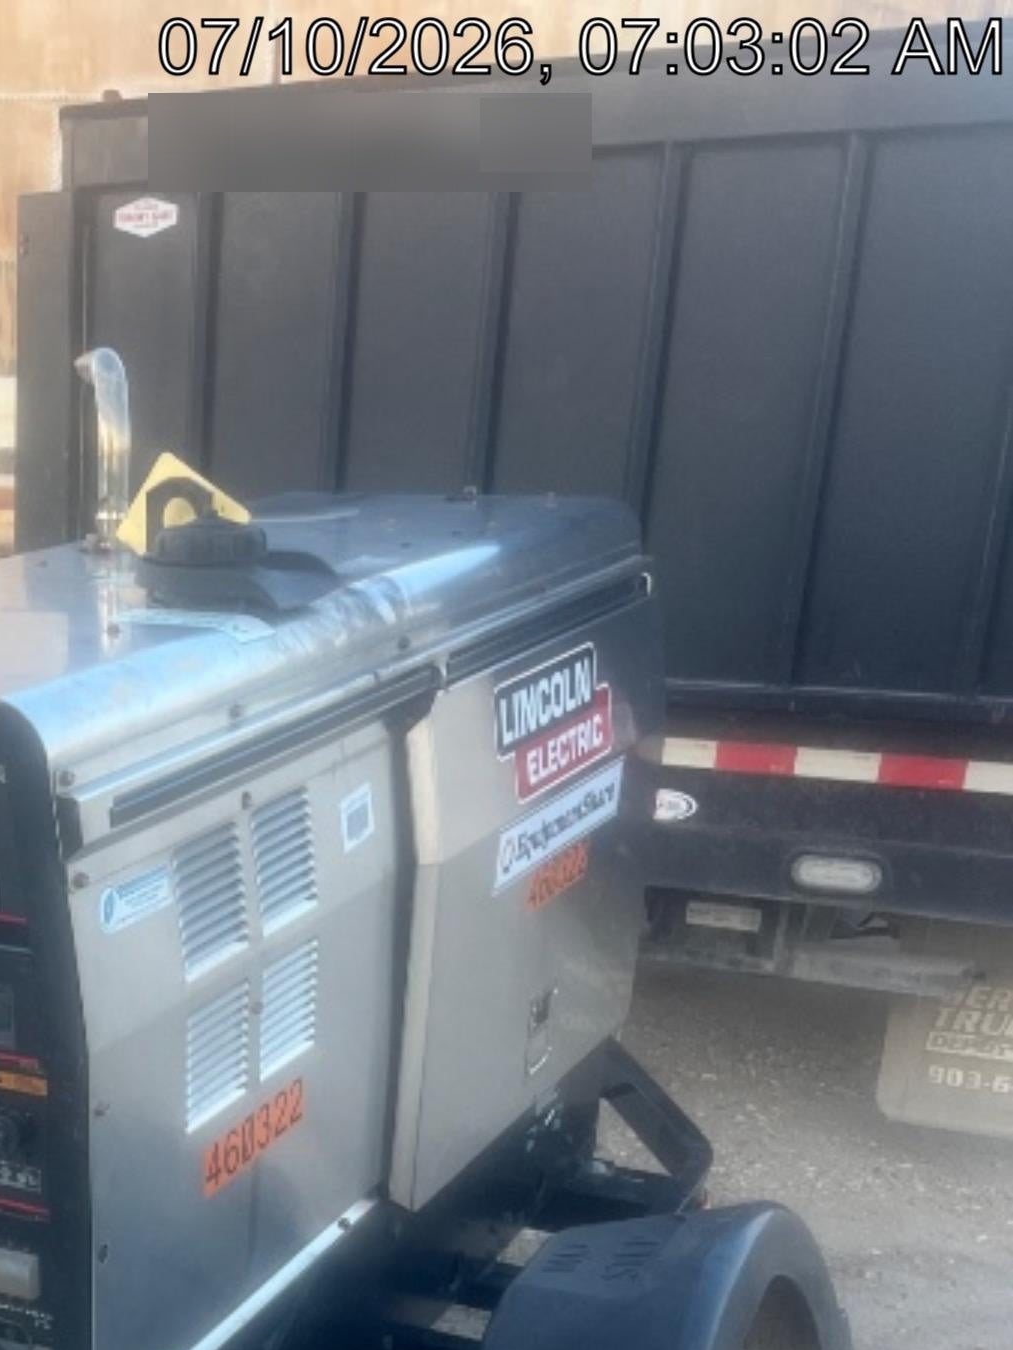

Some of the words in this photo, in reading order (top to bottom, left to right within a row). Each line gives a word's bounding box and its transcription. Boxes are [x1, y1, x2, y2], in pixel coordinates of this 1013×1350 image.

[499, 656, 592, 746] LINCOLN
[526, 713, 604, 787] ELECTRIC
[205, 1078, 303, 1185] 460322
